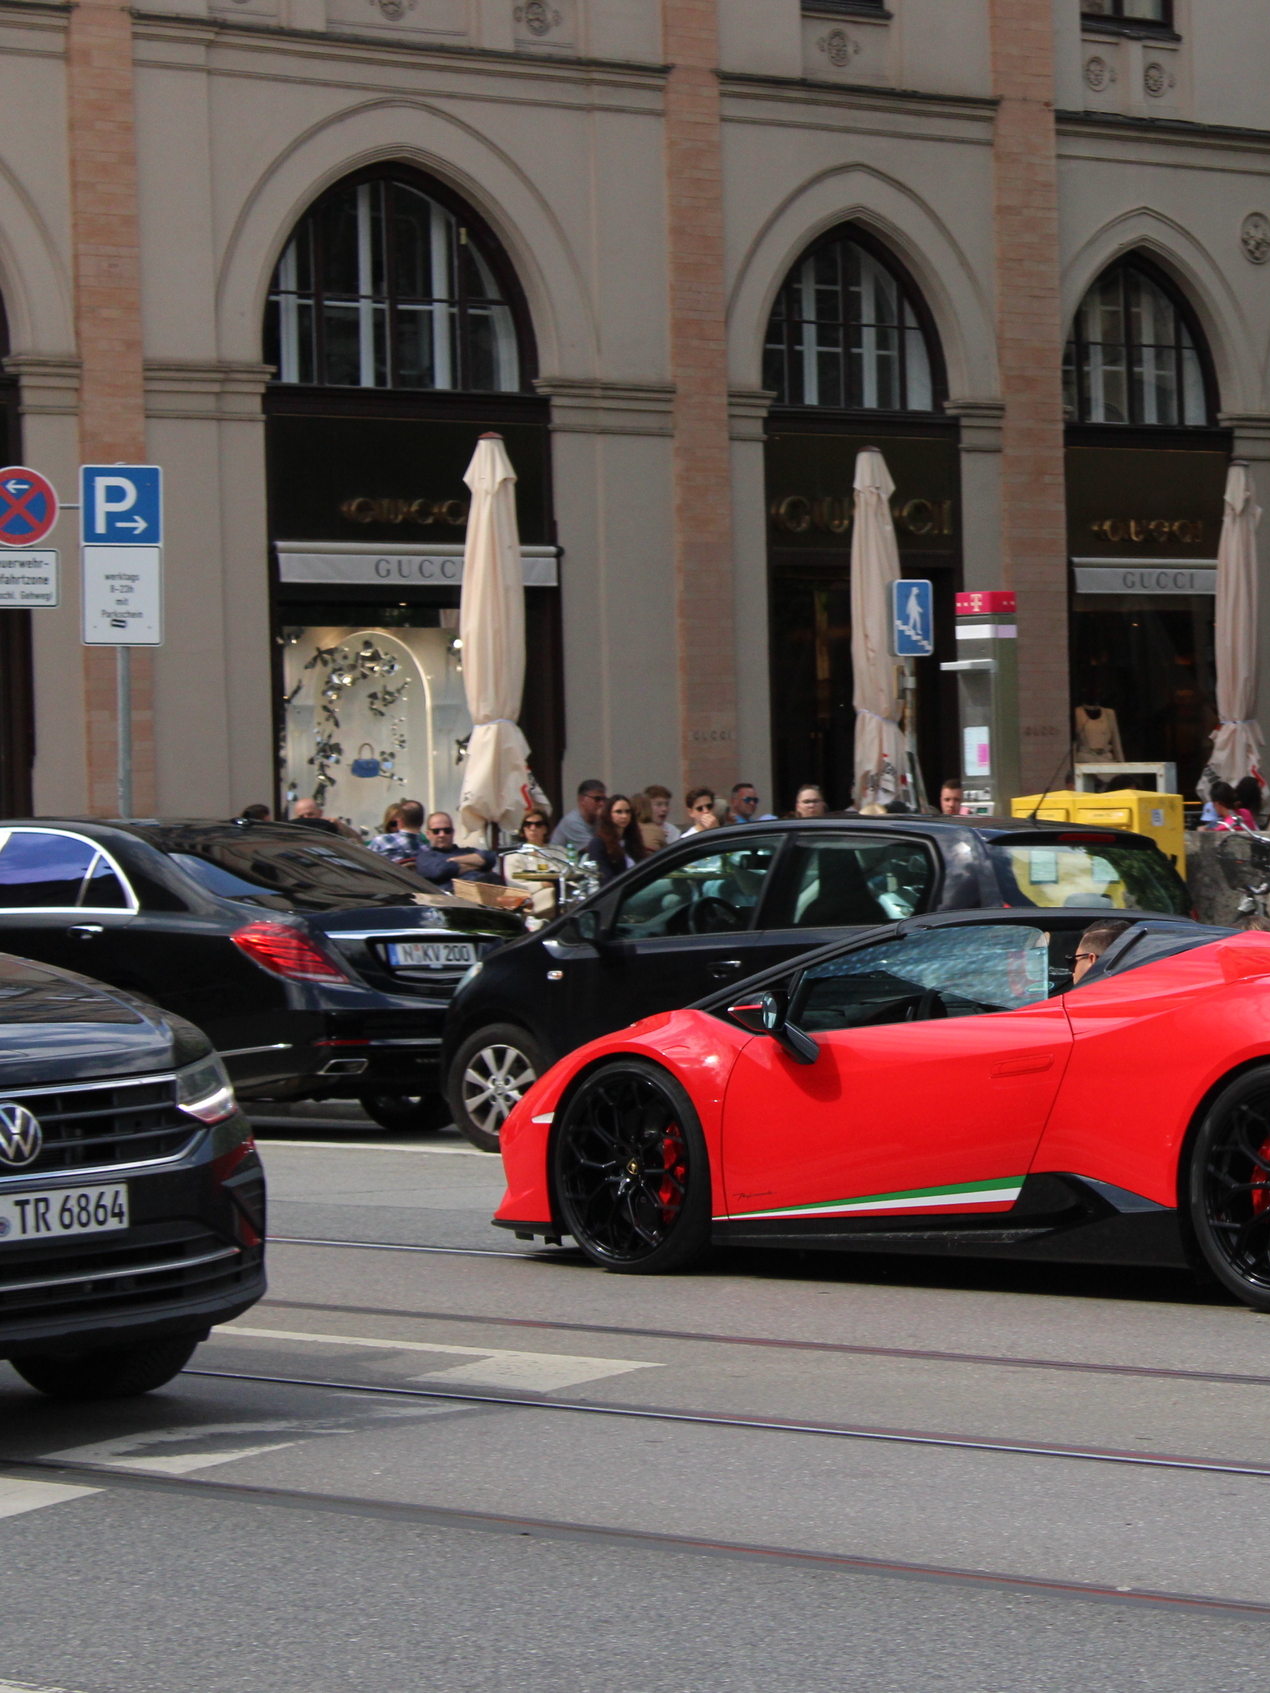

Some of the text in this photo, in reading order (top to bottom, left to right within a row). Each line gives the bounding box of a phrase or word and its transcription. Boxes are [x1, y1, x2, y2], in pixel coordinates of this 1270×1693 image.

[94, 476, 137, 534] P
[342, 497, 467, 524] GUCC
[778, 496, 953, 535] GUCI
[0, 558, 49, 568] uerwehr-
[374, 559, 464, 579] GUCC
[0, 574, 49, 585] fahrtzone
[104, 572, 140, 583] werktags
[1122, 572, 1196, 589] GUCCI
[101, 610, 143, 618] Parkschein
[443, 945, 470, 961] 200
[14, 1190, 125, 1234] TR 6864
